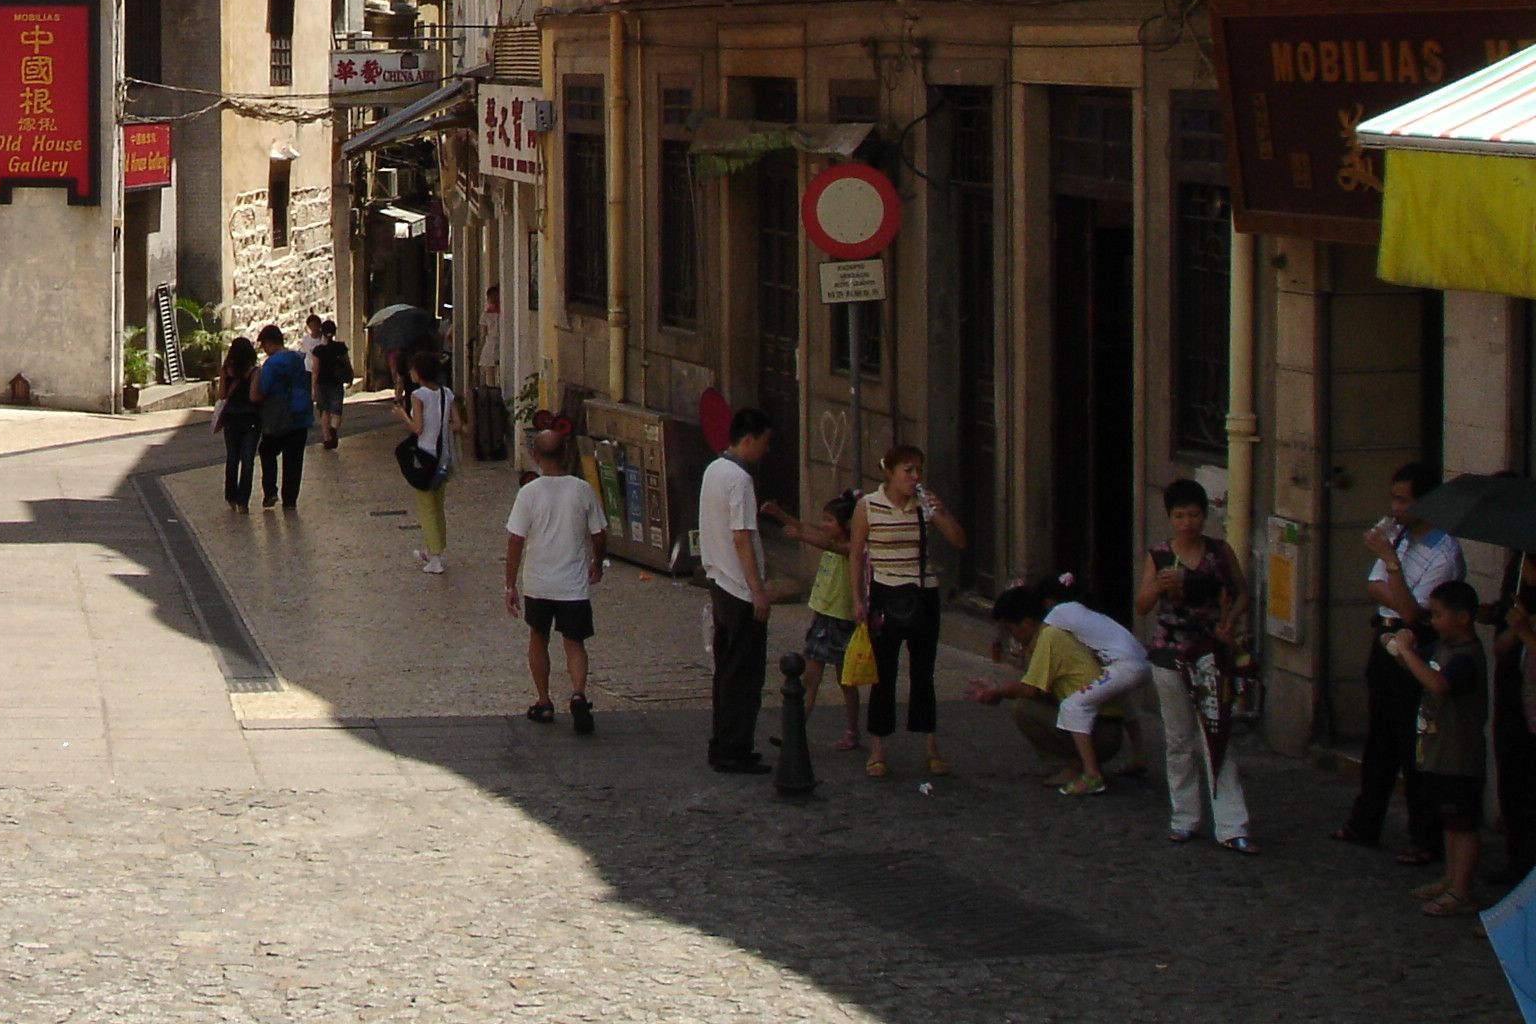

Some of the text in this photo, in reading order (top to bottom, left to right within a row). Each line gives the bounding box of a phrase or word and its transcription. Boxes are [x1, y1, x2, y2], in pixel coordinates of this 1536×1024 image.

[1270, 38, 1447, 83] MOBILIAS
[383, 69, 414, 83] CHINA
[32, 135, 82, 152] House
[8, 156, 69, 176] Gallery
